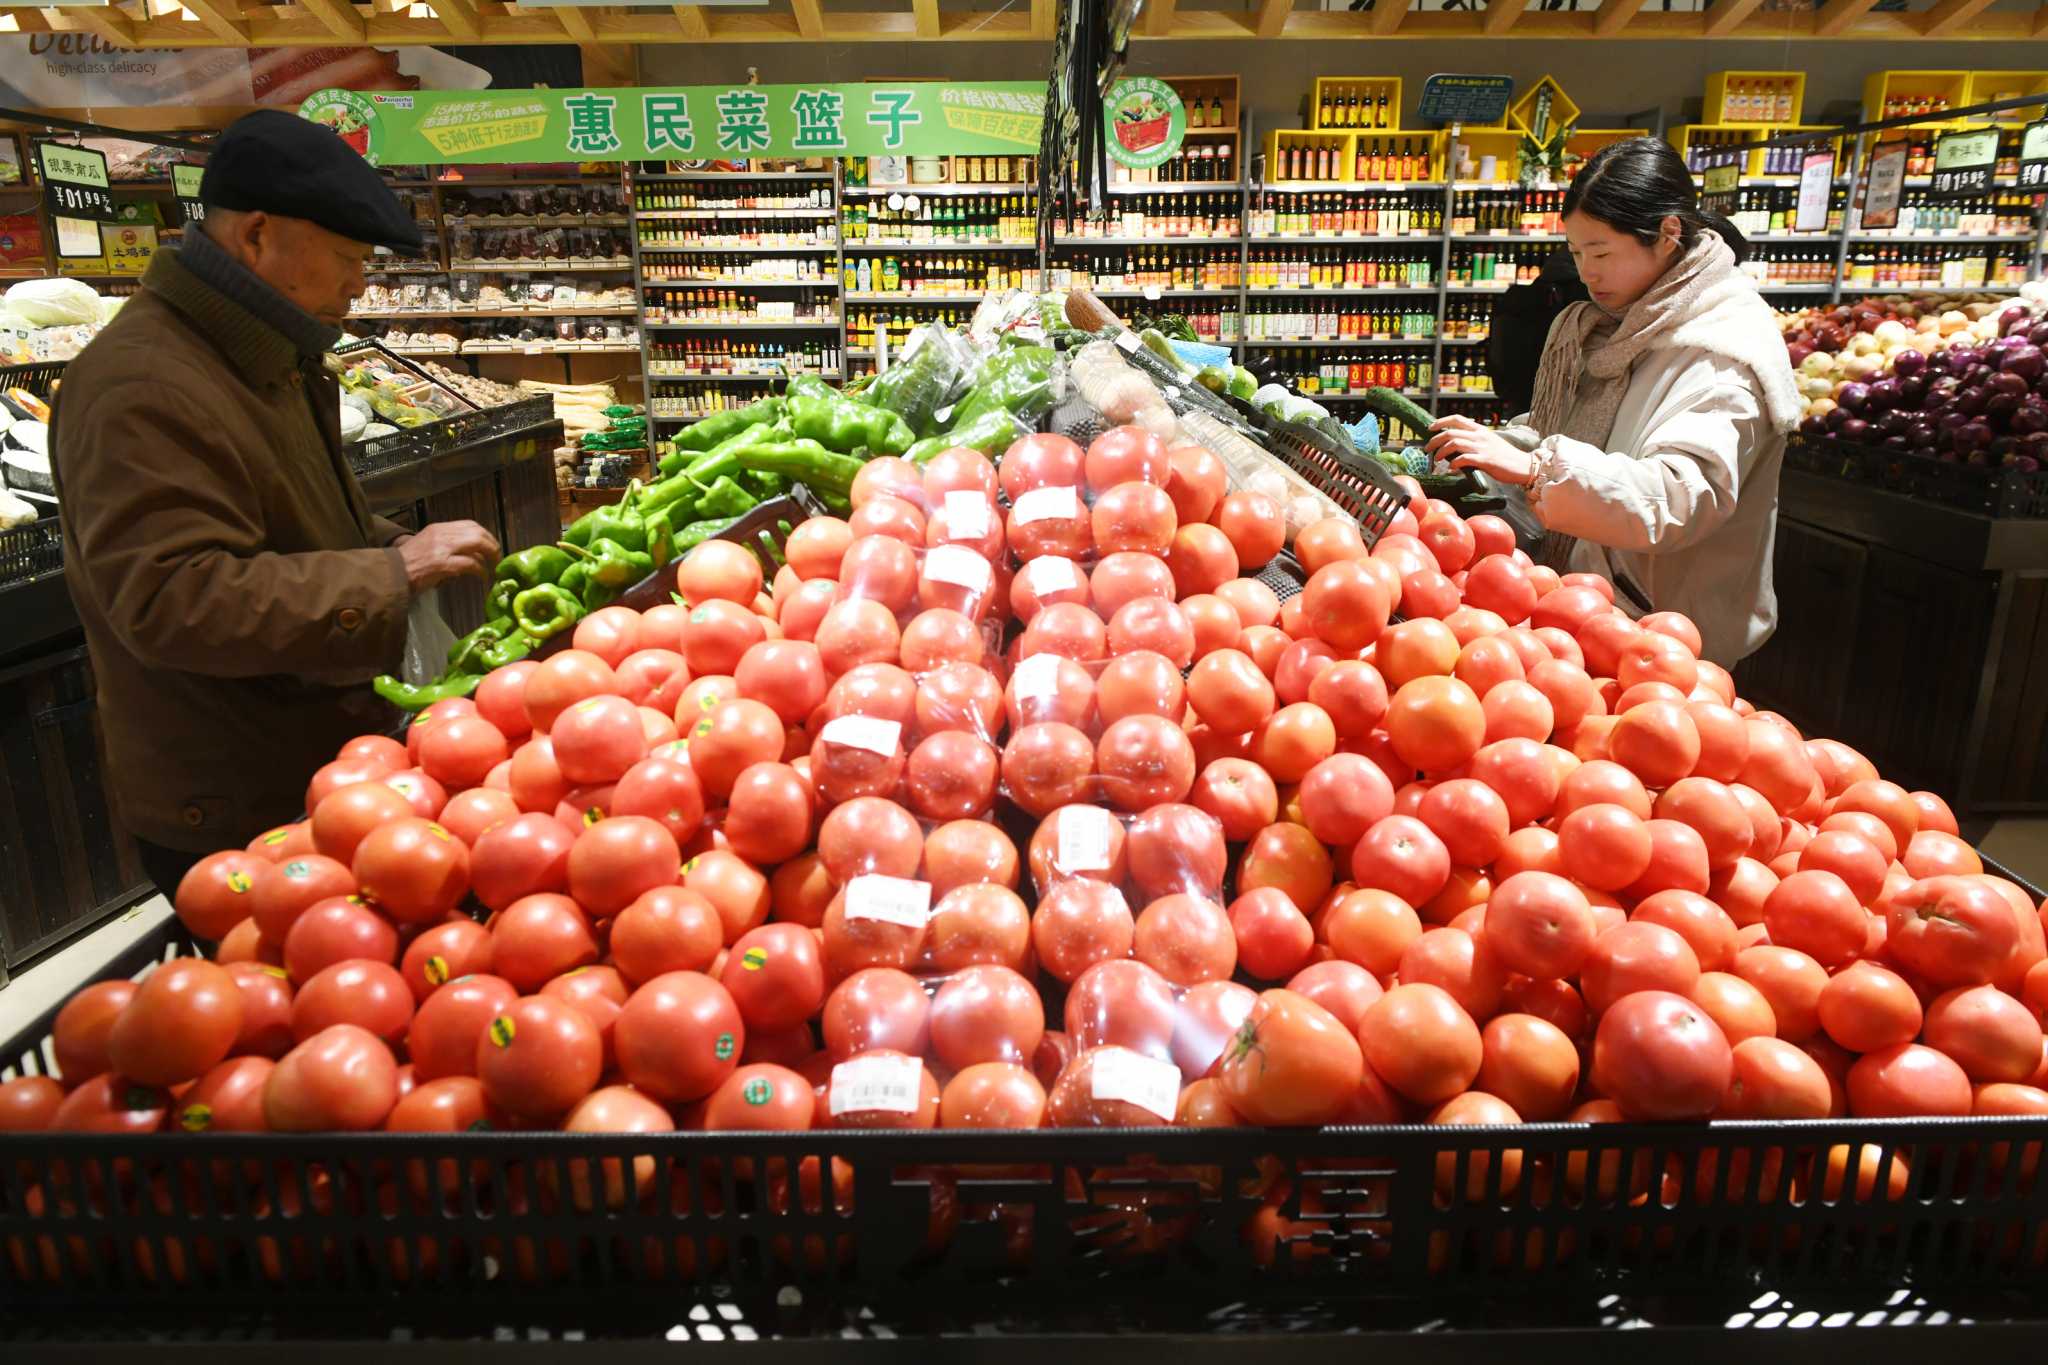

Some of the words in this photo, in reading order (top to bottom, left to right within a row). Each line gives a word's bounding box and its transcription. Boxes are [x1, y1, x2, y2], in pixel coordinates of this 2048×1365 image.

[46, 61, 106, 77] high-class
[109, 61, 157, 75] delicacy
[1105, 80, 1180, 110] 阜阳市民生工程
[423, 104, 547, 129] 市场价15%的蔬菜
[433, 101, 493, 116] 15种低于
[563, 90, 922, 154] 惠民菜篮子
[437, 120, 539, 151] 5种低于1元的蔬菜
[47, 157, 101, 179] 银栗南瓜
[113, 246, 151, 258] 土鸡蛋
[891, 1153, 1397, 1283] 万家福
